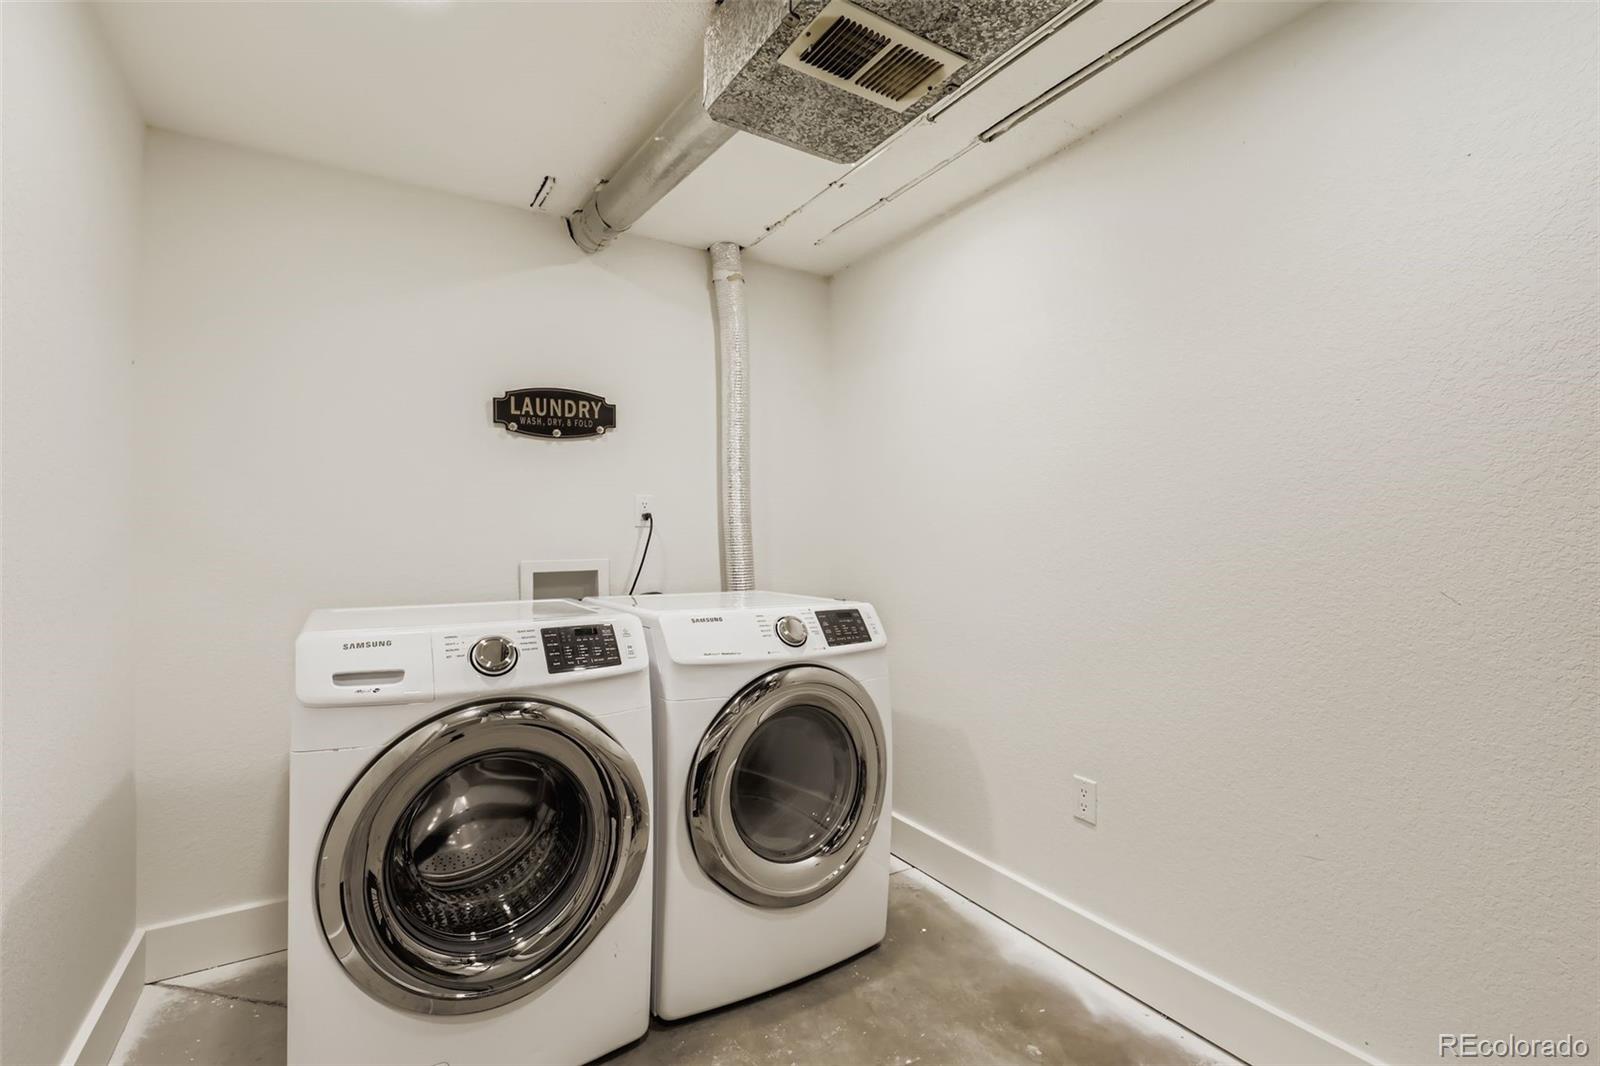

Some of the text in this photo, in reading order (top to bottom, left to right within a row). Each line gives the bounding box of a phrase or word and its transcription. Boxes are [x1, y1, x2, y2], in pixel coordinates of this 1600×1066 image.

[510, 396, 602, 418] LAUNDRY
[519, 417, 545, 427] WASH,
[547, 418, 564, 428] DRY,
[574, 419, 593, 428] FOLD
[690, 616, 724, 624] SAMSUNG
[342, 640, 393, 651] SAMSUNG
